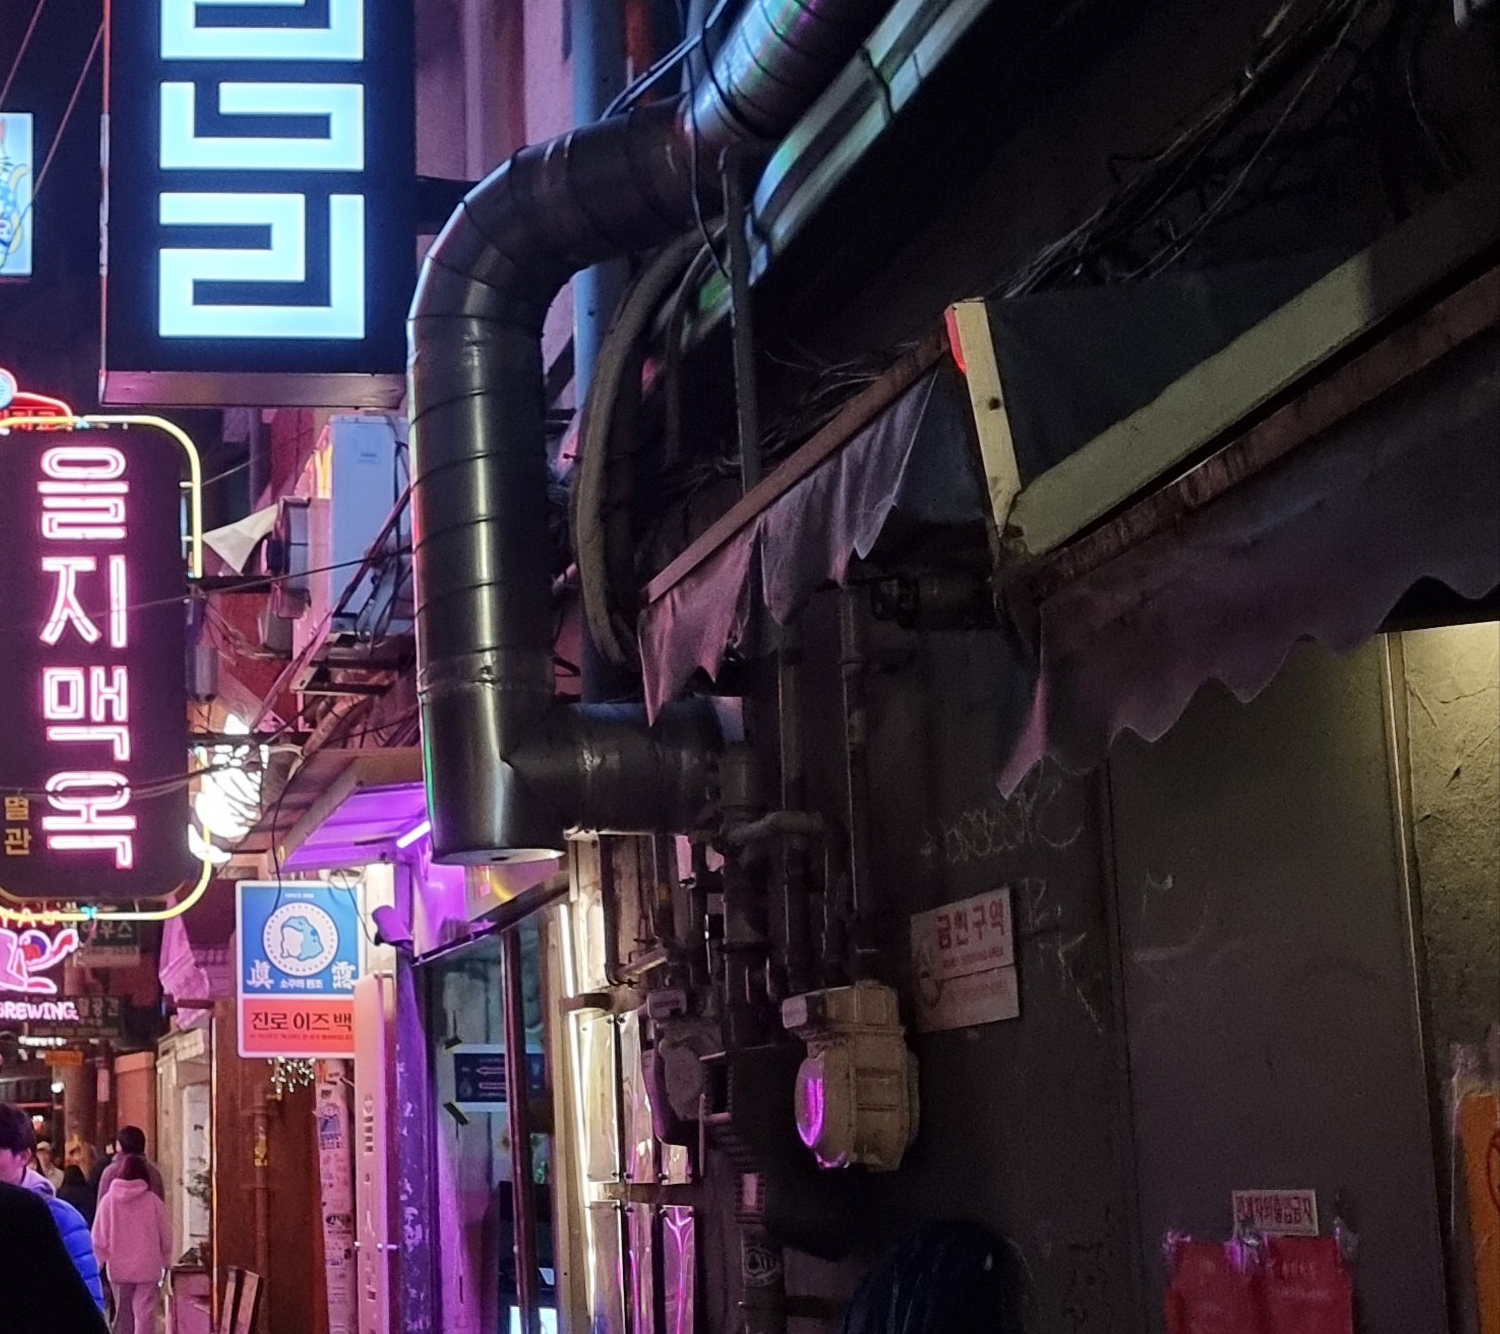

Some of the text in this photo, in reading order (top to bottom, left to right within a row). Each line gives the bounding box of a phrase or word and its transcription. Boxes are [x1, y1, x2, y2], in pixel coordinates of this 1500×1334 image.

[36, 445, 139, 870] 을지맥옥
[937, 898, 1005, 950] 금연구역
[251, 1011, 353, 1032] 진로 이즈 백
